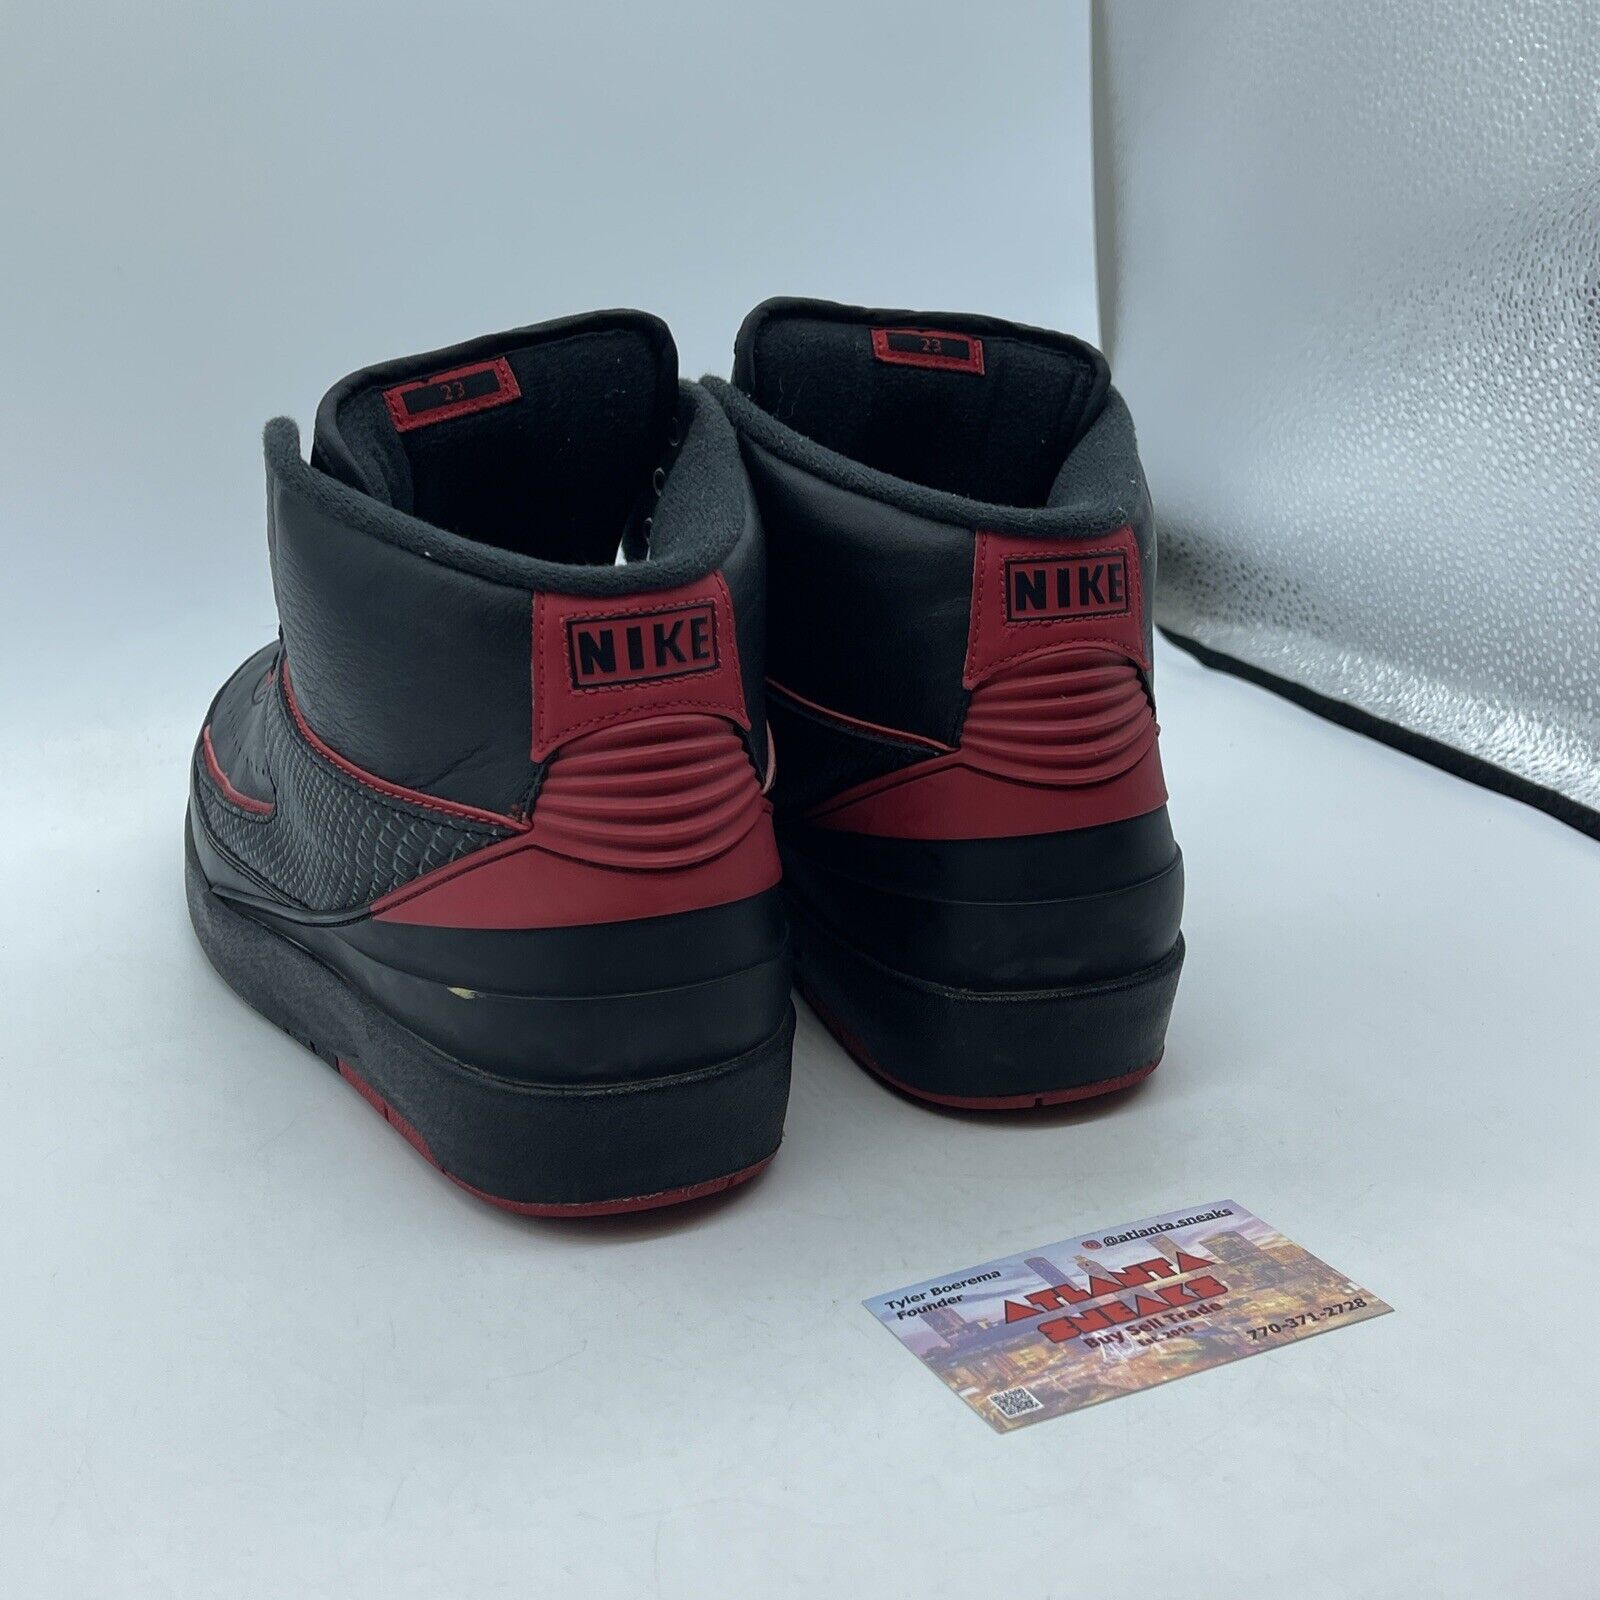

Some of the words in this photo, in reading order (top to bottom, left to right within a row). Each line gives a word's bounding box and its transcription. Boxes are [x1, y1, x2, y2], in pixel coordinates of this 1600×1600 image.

[920, 338, 941, 353] 23
[439, 381, 465, 401] 23
[1014, 563, 1124, 611] NIKE
[577, 616, 710, 676] NIKE
[1103, 1207, 1234, 1248] @atlanta.sneaks
[884, 1292, 927, 1310] Tyler
[929, 1270, 1002, 1296] Boerema
[896, 1294, 964, 1321] Founder
[1005, 1251, 1216, 1324] ATLANTA
[1037, 1275, 1229, 1344] SNEAKS
[1083, 1330, 1125, 1349] Buy
[1125, 1317, 1165, 1336] Sell
[1162, 1301, 1224, 1324] Trade
[1246, 1298, 1368, 1341] 770-371-2728
[1163, 1324, 1195, 1340] 2015
